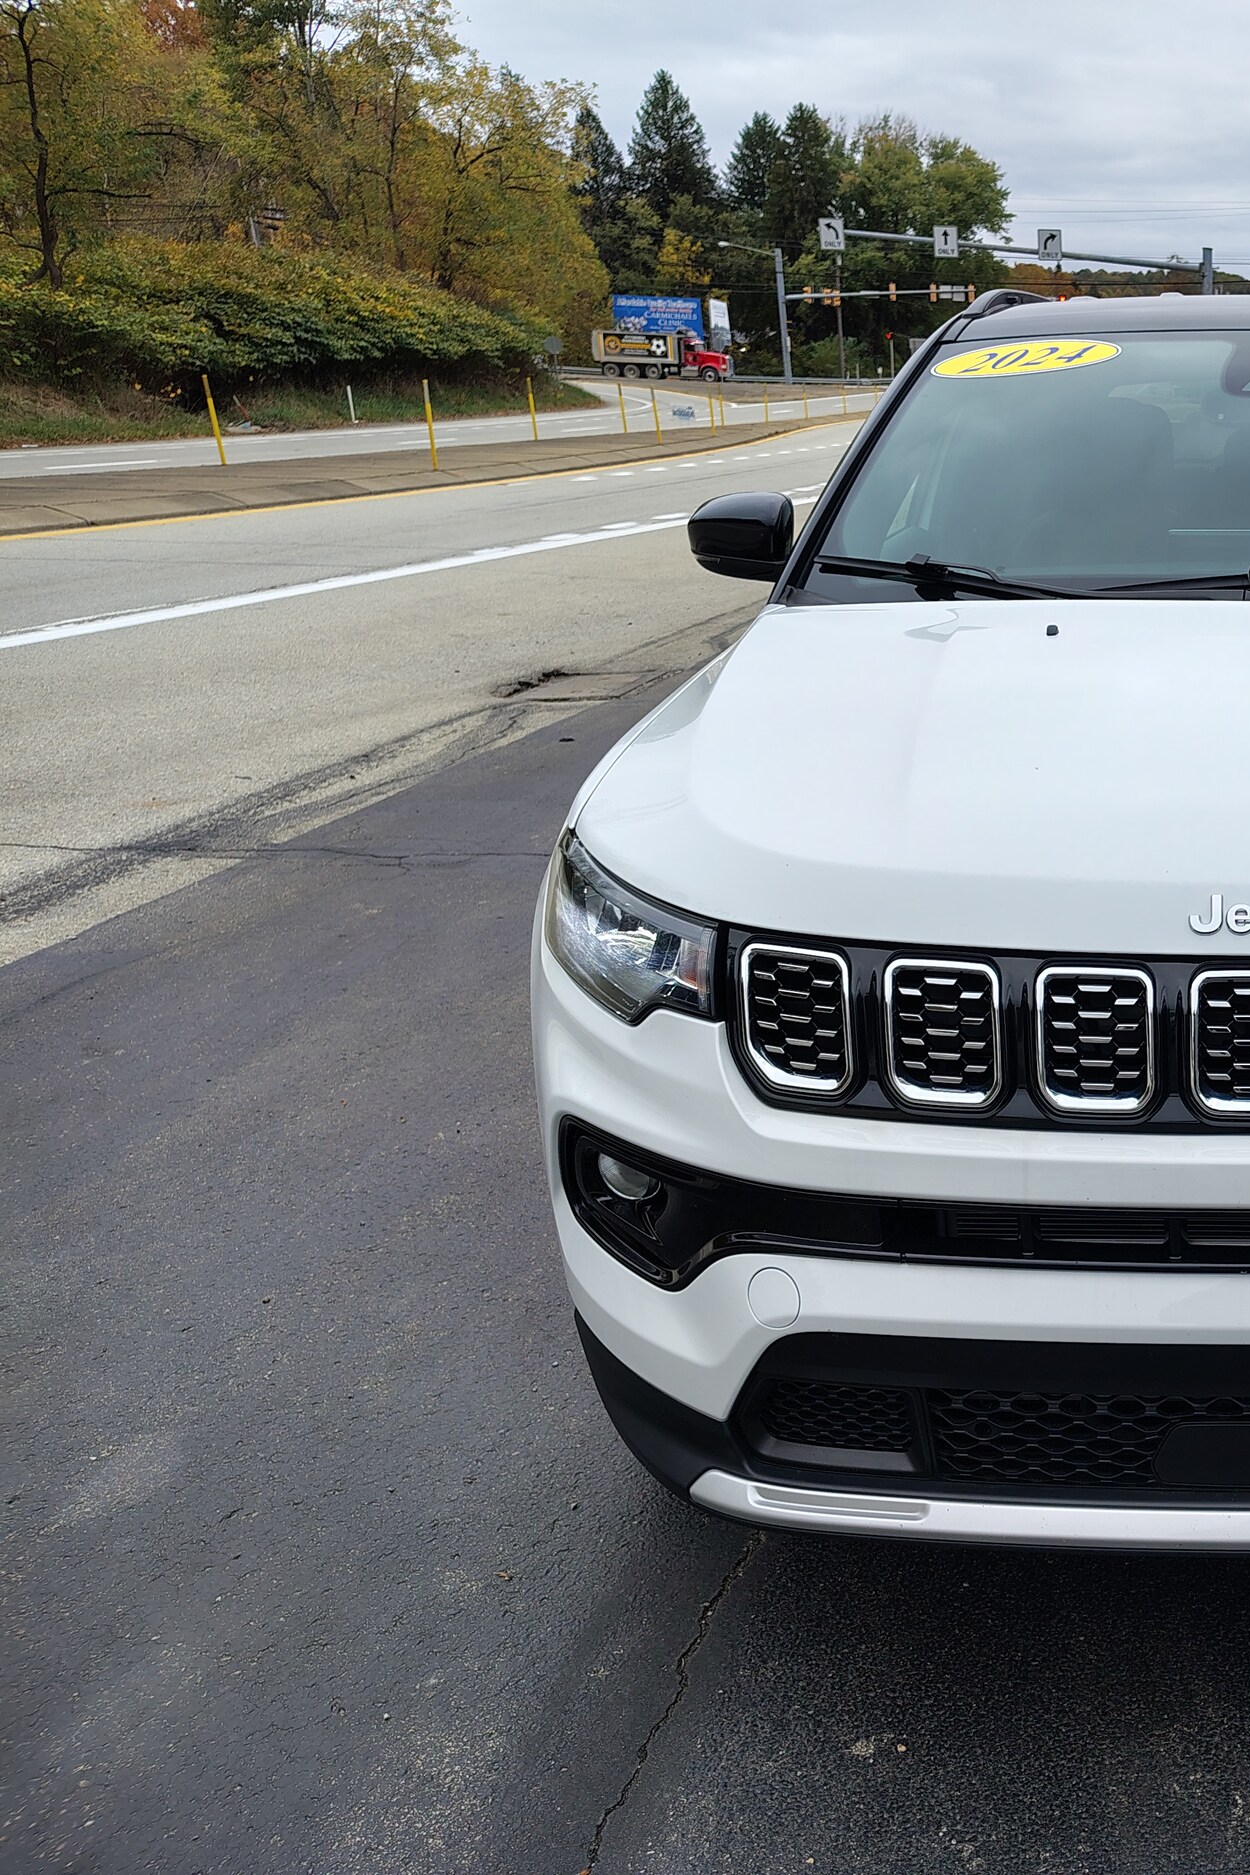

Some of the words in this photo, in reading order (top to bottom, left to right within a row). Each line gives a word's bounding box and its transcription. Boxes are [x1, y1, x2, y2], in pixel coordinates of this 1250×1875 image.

[823, 240, 842, 249] ONLY
[937, 247, 956, 256] ONLY
[1040, 251, 1060, 259] ONLY
[957, 344, 1097, 375] 2024
